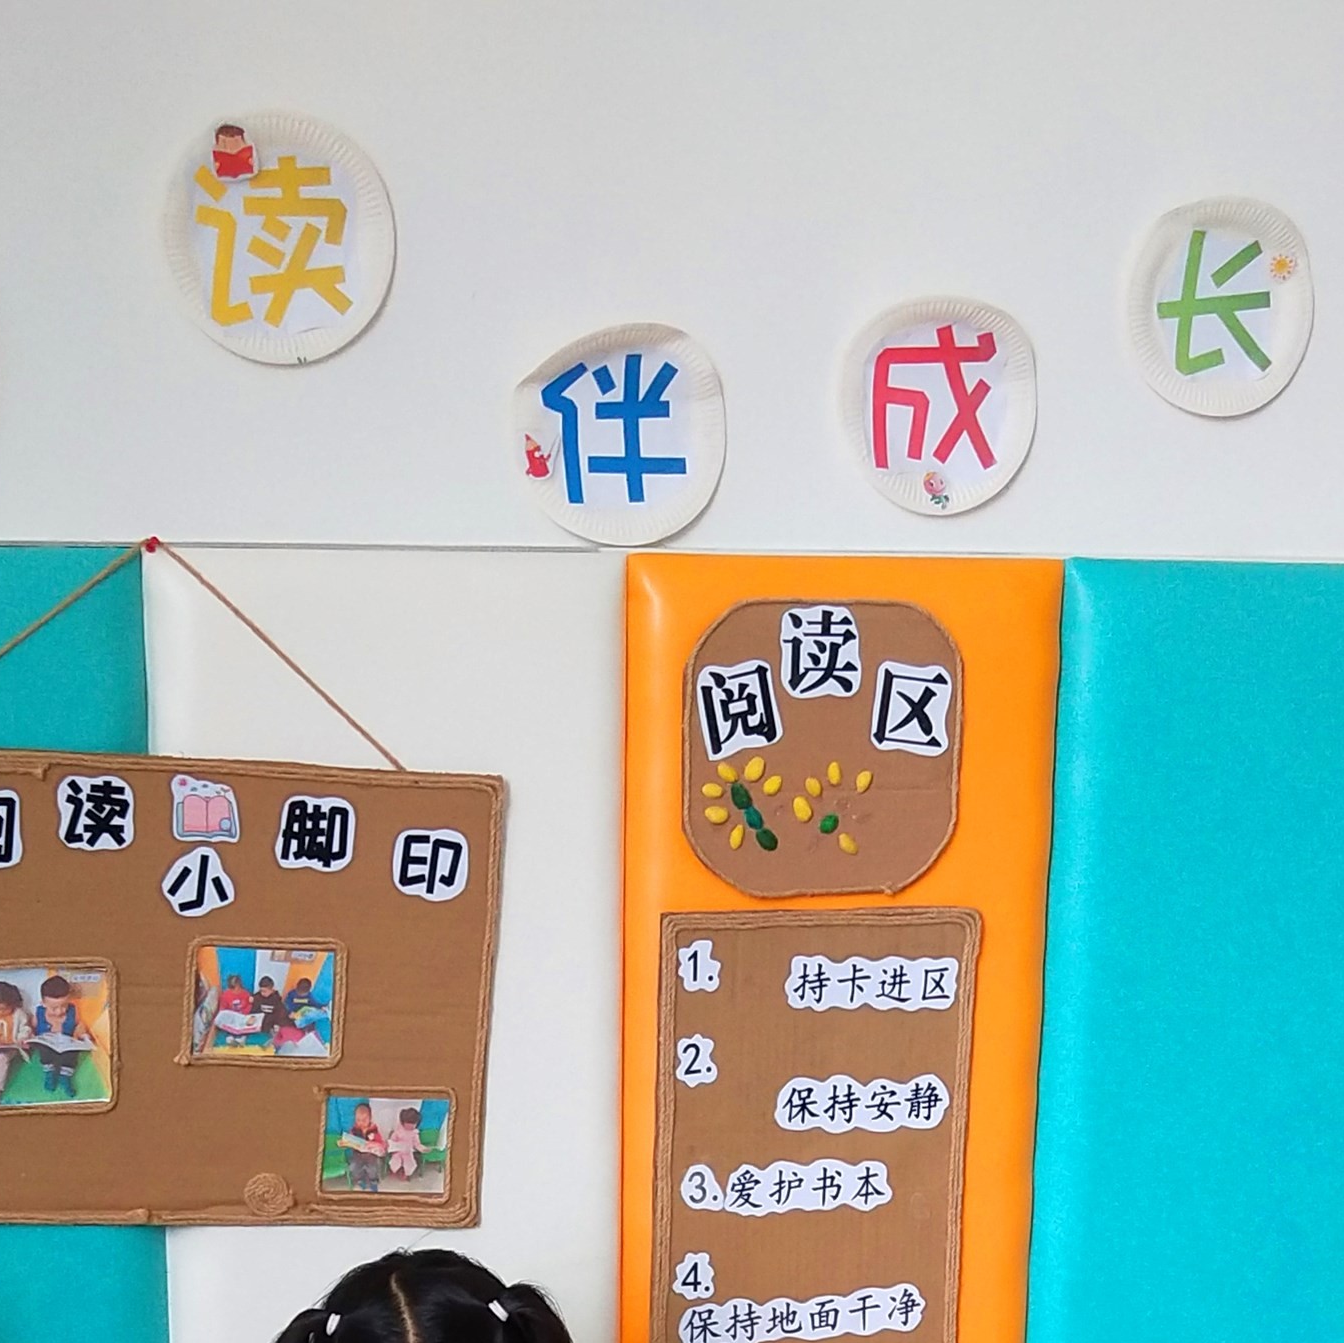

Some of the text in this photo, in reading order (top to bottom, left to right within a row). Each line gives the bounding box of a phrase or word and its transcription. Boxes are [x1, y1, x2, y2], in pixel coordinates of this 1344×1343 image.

[686, 950, 952, 1004] 1. 持卡进区
[681, 1042, 713, 1076] 2.
[781, 1082, 944, 1125] 保持安静
[687, 1166, 887, 1209] 3. 爱护书本
[680, 1261, 711, 1293] 4.
